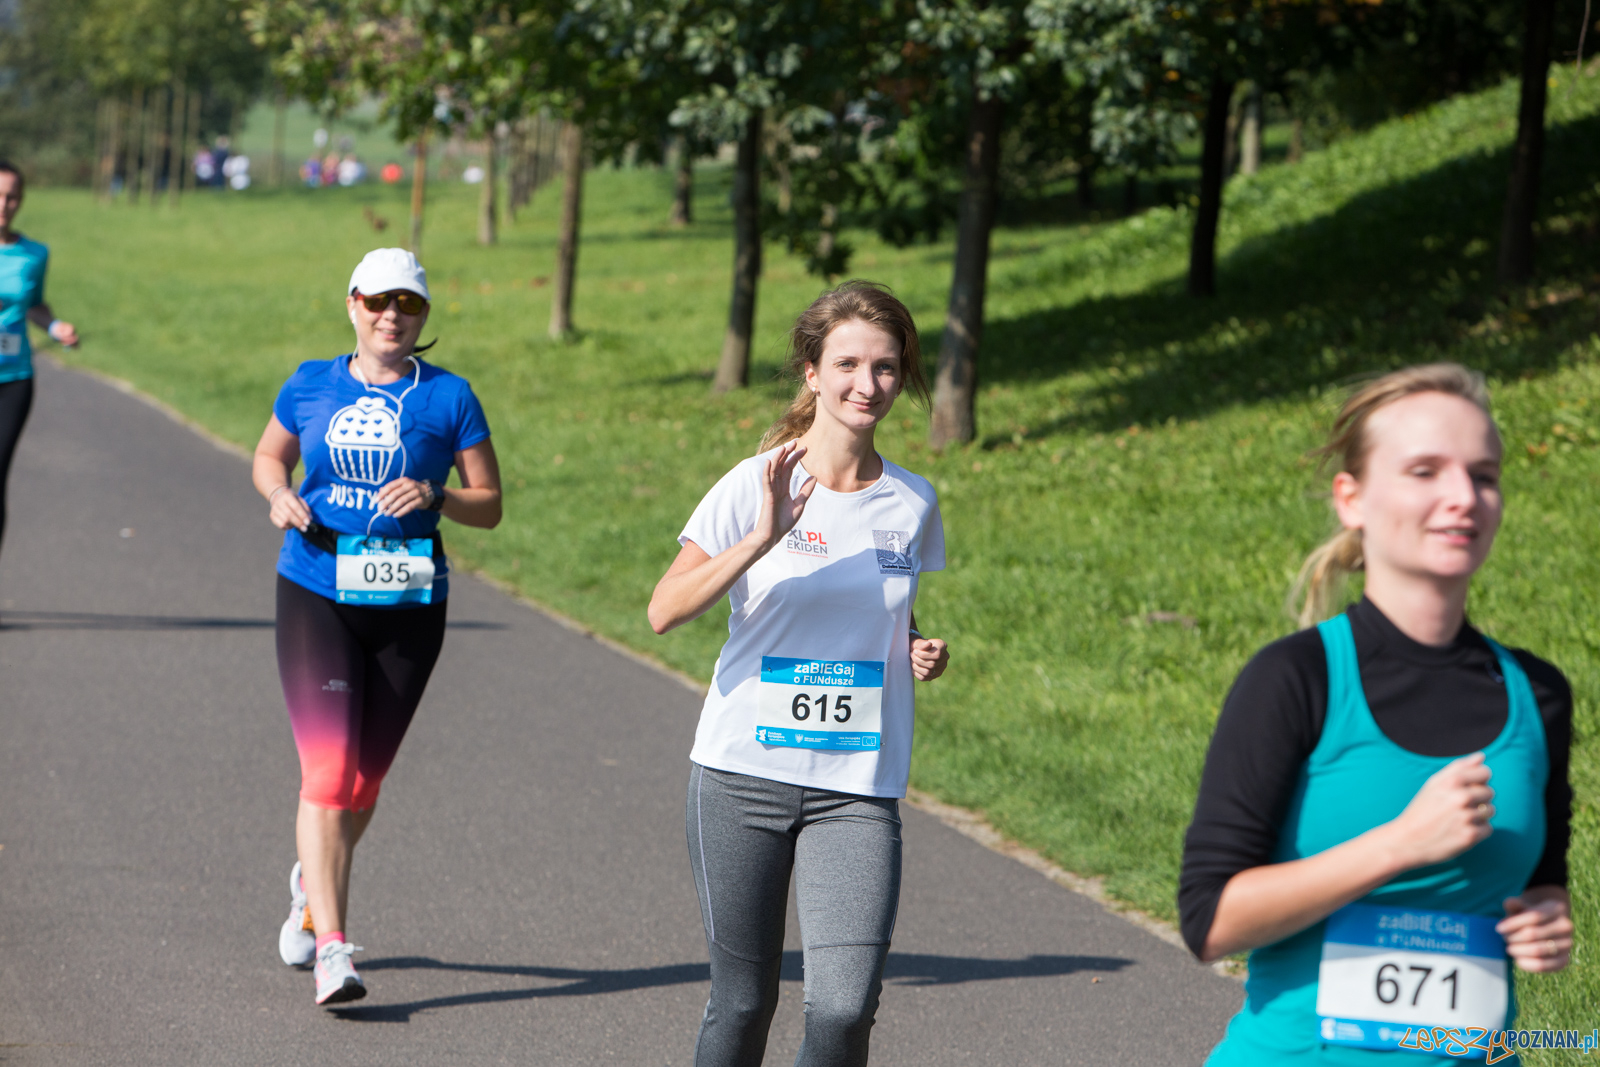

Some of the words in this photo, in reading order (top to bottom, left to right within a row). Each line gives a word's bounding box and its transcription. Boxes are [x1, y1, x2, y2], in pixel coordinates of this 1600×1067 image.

[327, 483, 379, 510] JUSTY
[787, 539, 828, 555] EKIDEN
[364, 562, 410, 583] 035
[793, 676, 801, 684] o
[803, 675, 854, 686] FUNdusze
[794, 662, 855, 678] zaBIEGaj
[791, 693, 852, 723] 615
[1375, 963, 1459, 1010] 671
